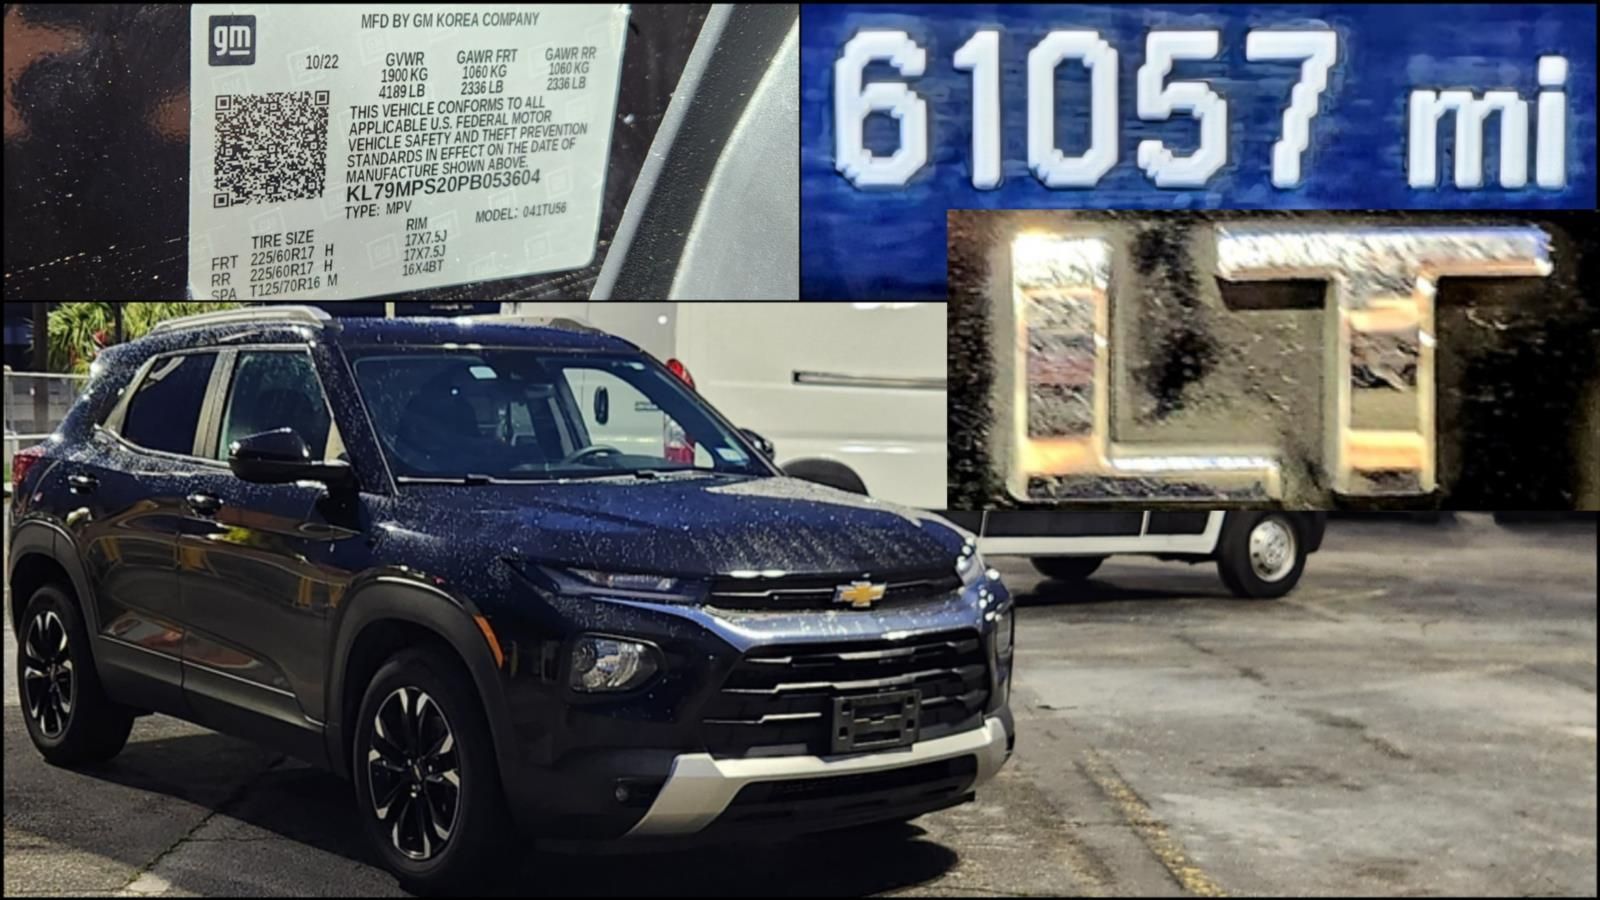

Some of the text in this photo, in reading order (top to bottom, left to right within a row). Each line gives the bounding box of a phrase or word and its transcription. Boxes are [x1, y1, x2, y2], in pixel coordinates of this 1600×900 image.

[361, 12, 540, 29] MFD BY GM KOREA COMPANY
[214, 25, 251, 56] gm
[305, 54, 339, 70] 10/22
[385, 52, 424, 67] GVWR
[456, 49, 518, 64] GAWR FRT
[545, 46, 597, 61] GAWR RR
[381, 67, 428, 83] 1900 KG
[462, 64, 508, 79] 1060 KG
[549, 61, 590, 76] 1060 KG
[378, 83, 425, 99] 4189 LB
[461, 80, 504, 95] 2336 LB
[547, 76, 586, 91] 2336 LB
[350, 96, 545, 120] THIS VEHICLE CONFORMS TO ALL
[834, 29, 1568, 189] 61057 mi
[349, 110, 552, 136] APPLICABLE U.S. FEDERAL MOTOR
[348, 123, 588, 152] VEHICLE SAFETY AND THEFT PREVENTION
[347, 137, 576, 168] STANDARDS IN EFFECT ON THE DATE OF
[346, 156, 529, 184] MANUFACTURE SHOWN ABOVE.
[346, 169, 541, 202] KL79MPS20PB053604
[345, 200, 412, 219] TYPE: MPV
[475, 202, 567, 223] MODEL: 041TU56
[406, 217, 428, 231] RIM
[251, 229, 315, 249] TIRE SIZE
[404, 230, 447, 247] 17X7.5J
[211, 243, 334, 271] FRT 225/60R17 H
[403, 245, 446, 261] 17X7.5J
[211, 259, 333, 287] RR 225/60R17 H
[402, 260, 443, 276] 16X4BT
[211, 273, 338, 300] SPA T125/70R16 M
[1007, 222, 1553, 500] LT
